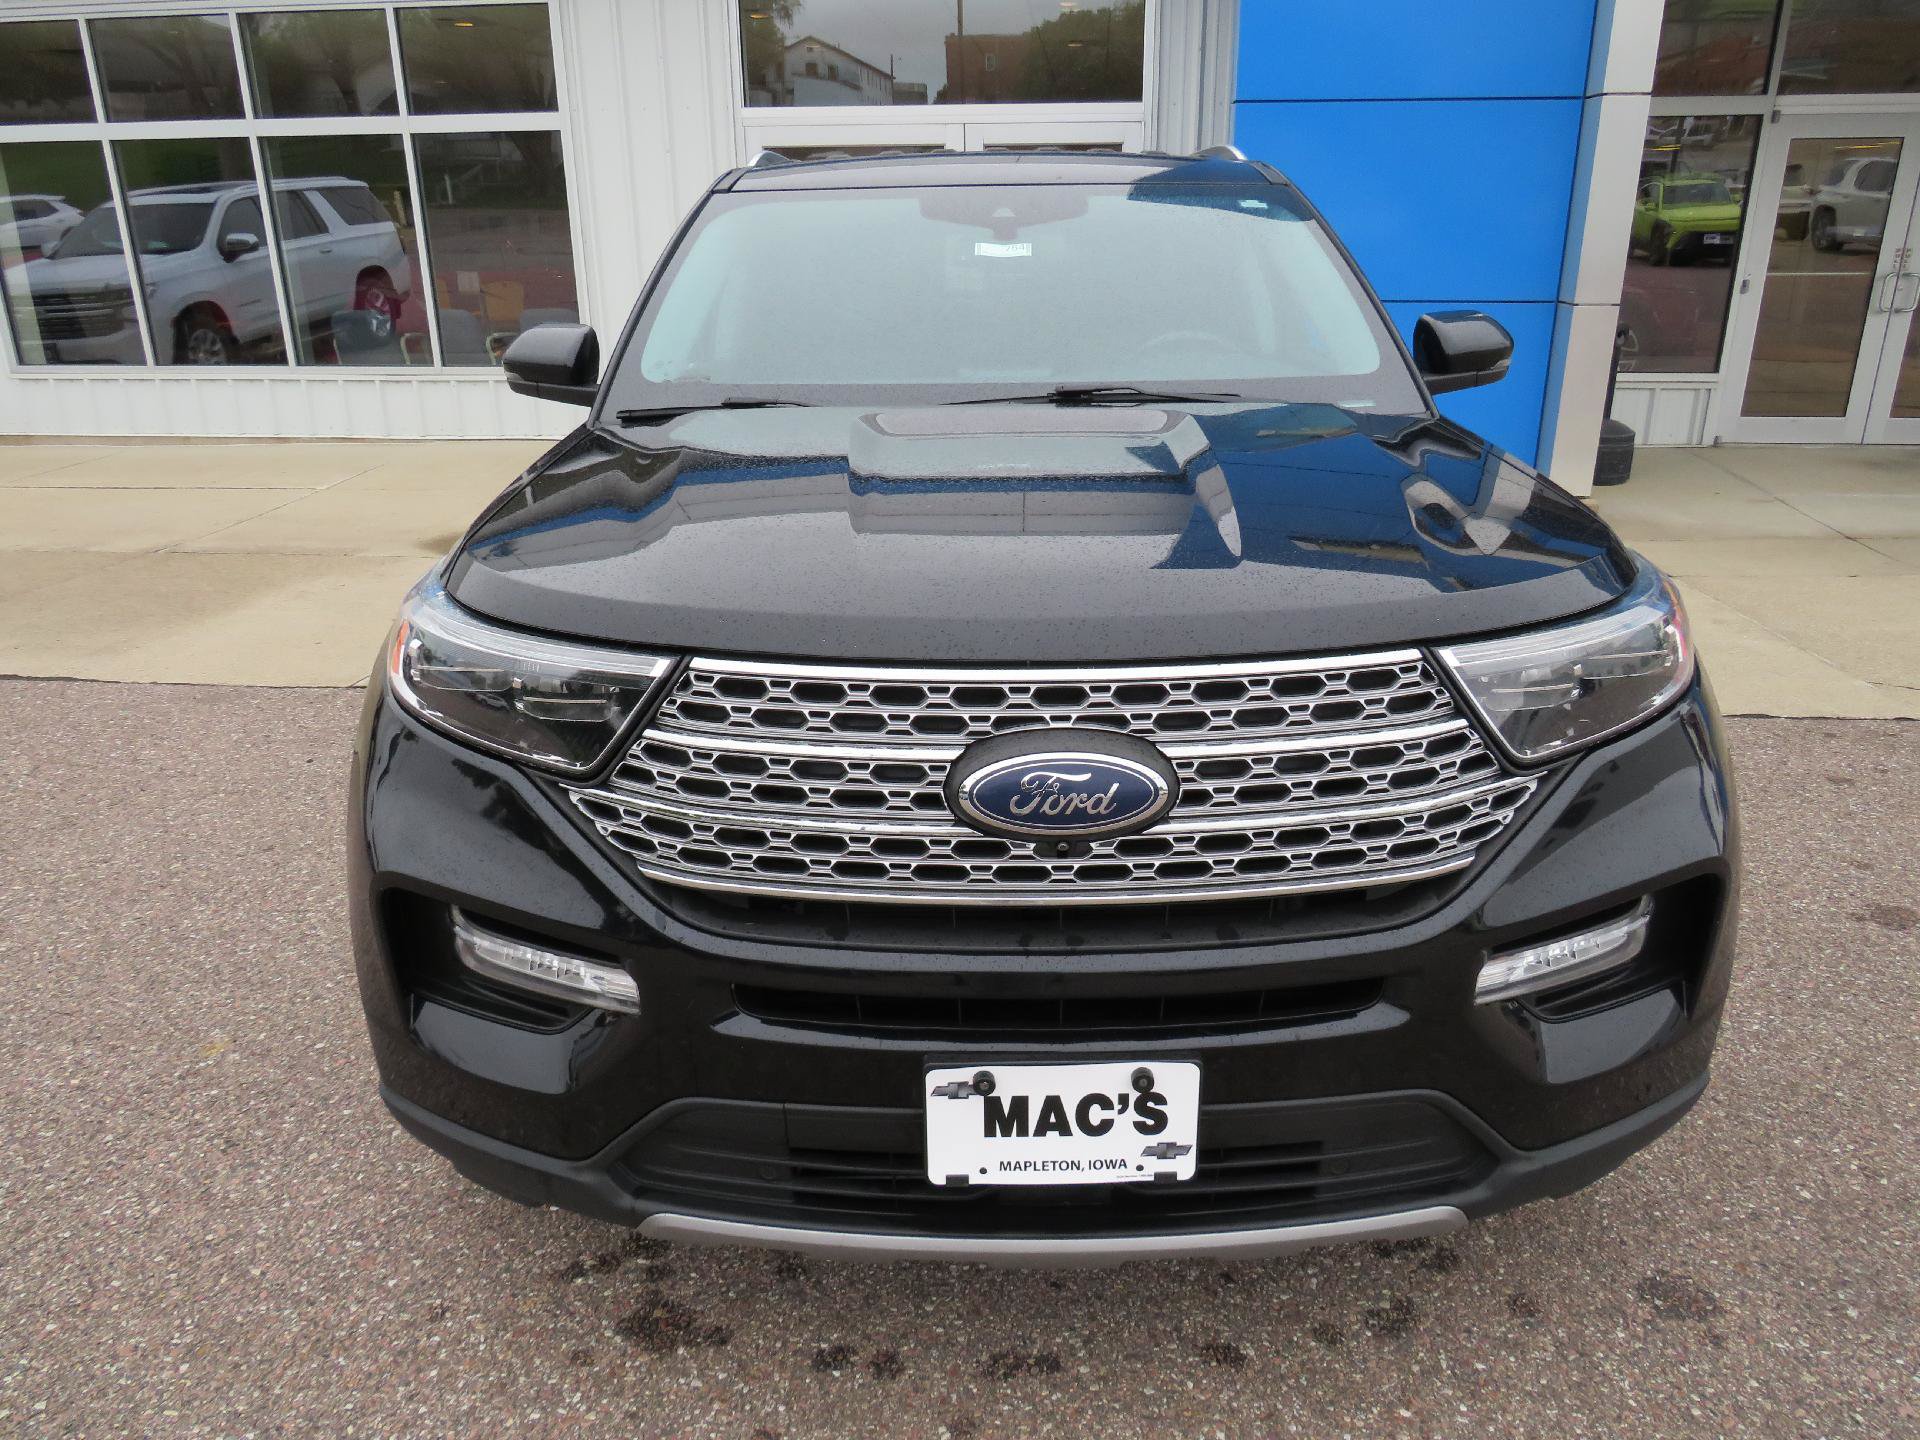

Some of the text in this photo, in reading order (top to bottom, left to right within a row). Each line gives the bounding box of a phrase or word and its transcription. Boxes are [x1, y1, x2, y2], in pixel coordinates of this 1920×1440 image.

[1009, 771, 1120, 817] Ford
[983, 1091, 1169, 1138] MAC'S
[999, 1158, 1128, 1173] MAPLETON, IOWA
